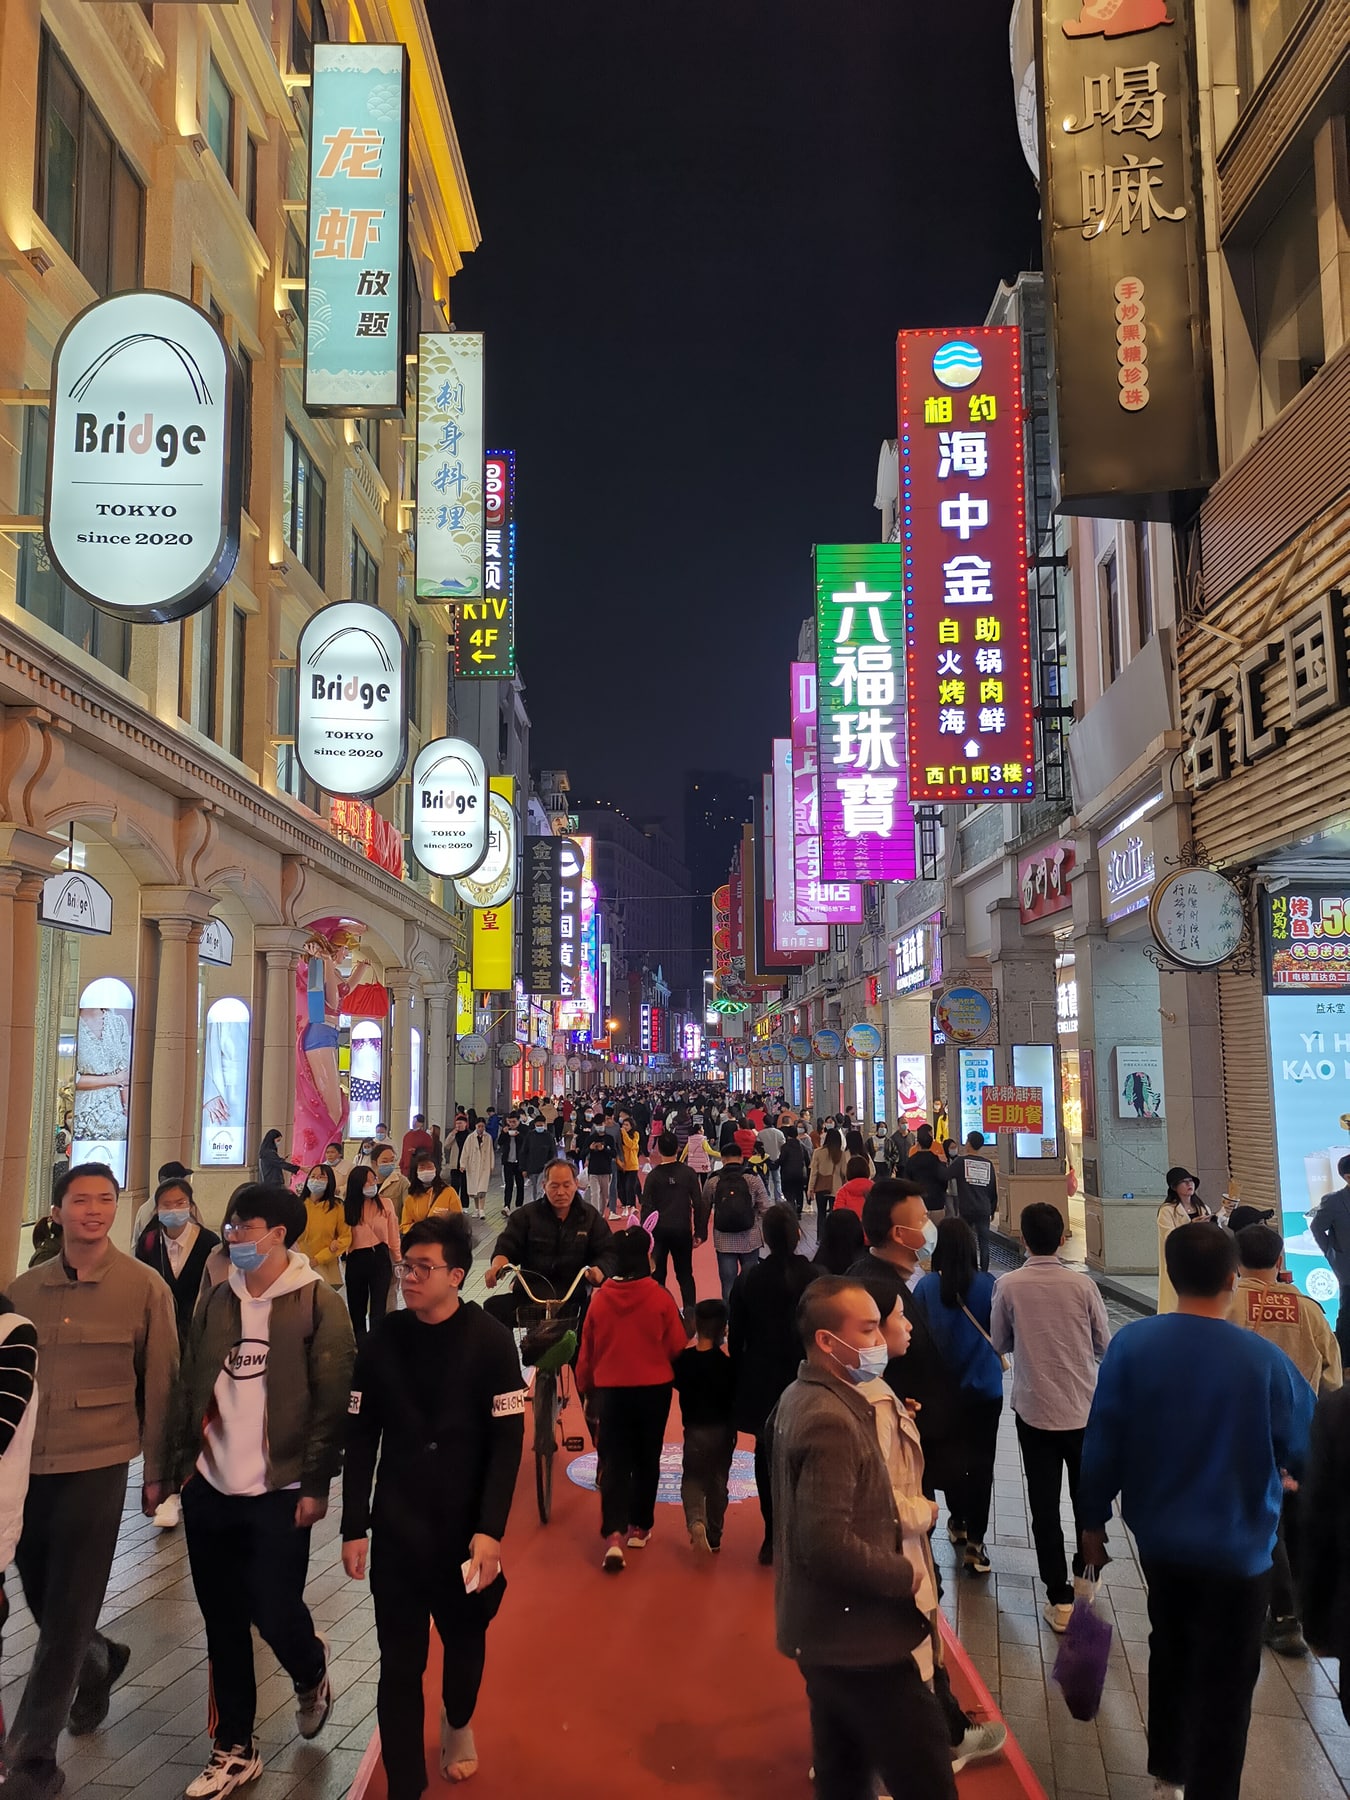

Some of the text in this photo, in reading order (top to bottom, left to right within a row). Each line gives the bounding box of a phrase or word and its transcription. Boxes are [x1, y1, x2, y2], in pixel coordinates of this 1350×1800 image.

[1063, 61, 1186, 239] 喝嘛
[313, 127, 384, 260] 龙虾
[355, 269, 390, 338] 放题
[1119, 282, 1143, 405] 手炒黑糖珍珠
[924, 394, 997, 425] 相约
[74, 411, 207, 467] Bridge
[433, 380, 466, 531] 刺身料理
[95, 503, 178, 518] TOKYO
[937, 431, 994, 604] 海中金
[76, 532, 194, 547] since 2020
[463, 598, 508, 620] KTV
[469, 629, 498, 648] 4F
[938, 615, 1001, 645] 自助
[937, 647, 1003, 675] 火锅
[311, 673, 391, 710] Bridge
[938, 677, 1005, 706] 烤肉
[831, 581, 899, 838] 六福珠寶
[939, 706, 1007, 735] 海鲜
[325, 730, 374, 741] TOKYO
[313, 747, 384, 758] since 2020
[925, 763, 1023, 786] 西门町3楼
[421, 790, 478, 815] Bridge
[447, 841, 473, 850] 2020
[481, 910, 500, 931] 皇
[1290, 898, 1310, 937] 烤鱼
[1293, 944, 1350, 957] 免费送配
[1299, 1032, 1325, 1053] YI
[1282, 1059, 1336, 1080] KAO
[986, 1104, 1042, 1124] 自助餐
[212, 1142, 233, 1152] Bridge
